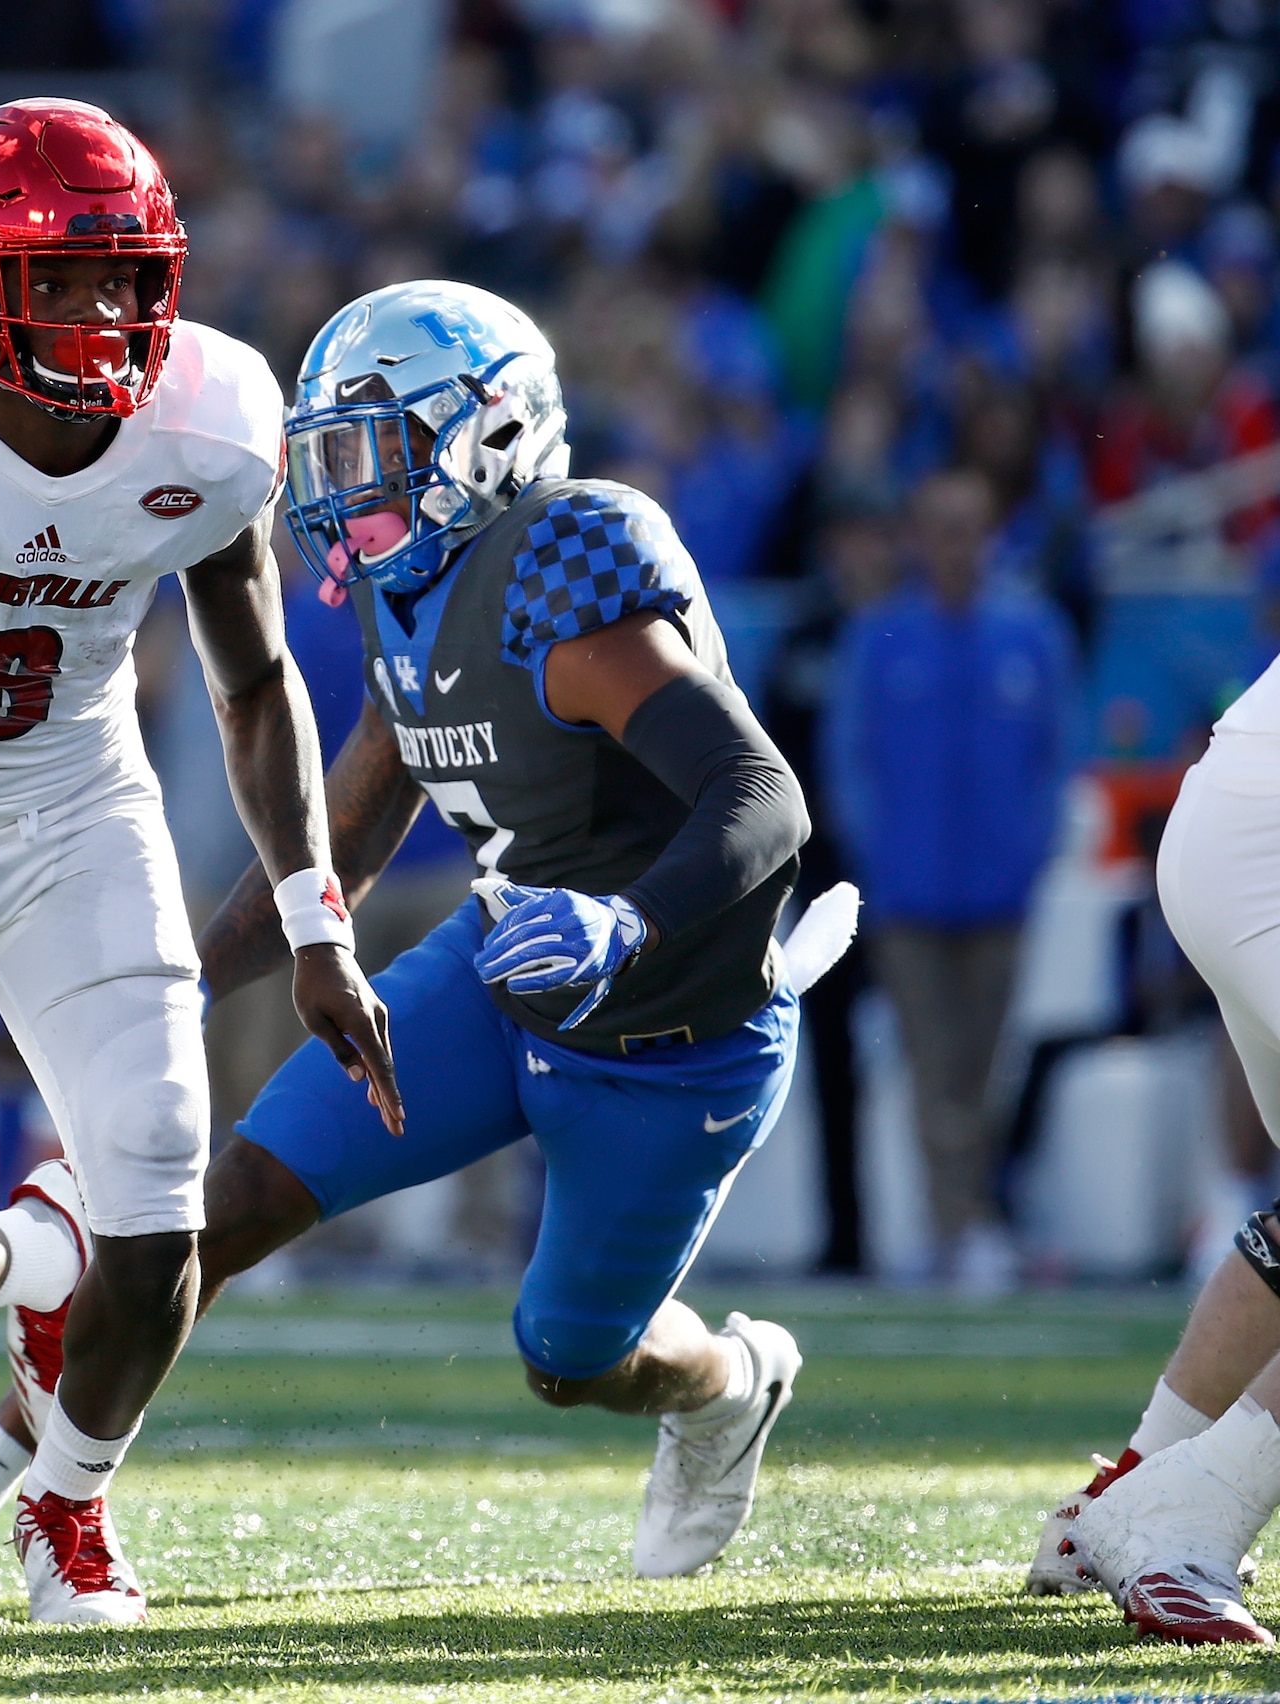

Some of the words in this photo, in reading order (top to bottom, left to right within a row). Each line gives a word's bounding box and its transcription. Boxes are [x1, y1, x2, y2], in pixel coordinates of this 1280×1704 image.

[147, 493, 197, 506] ACC
[15, 547, 68, 564] adidas
[392, 655, 421, 691] UK
[418, 779, 516, 881] 7
